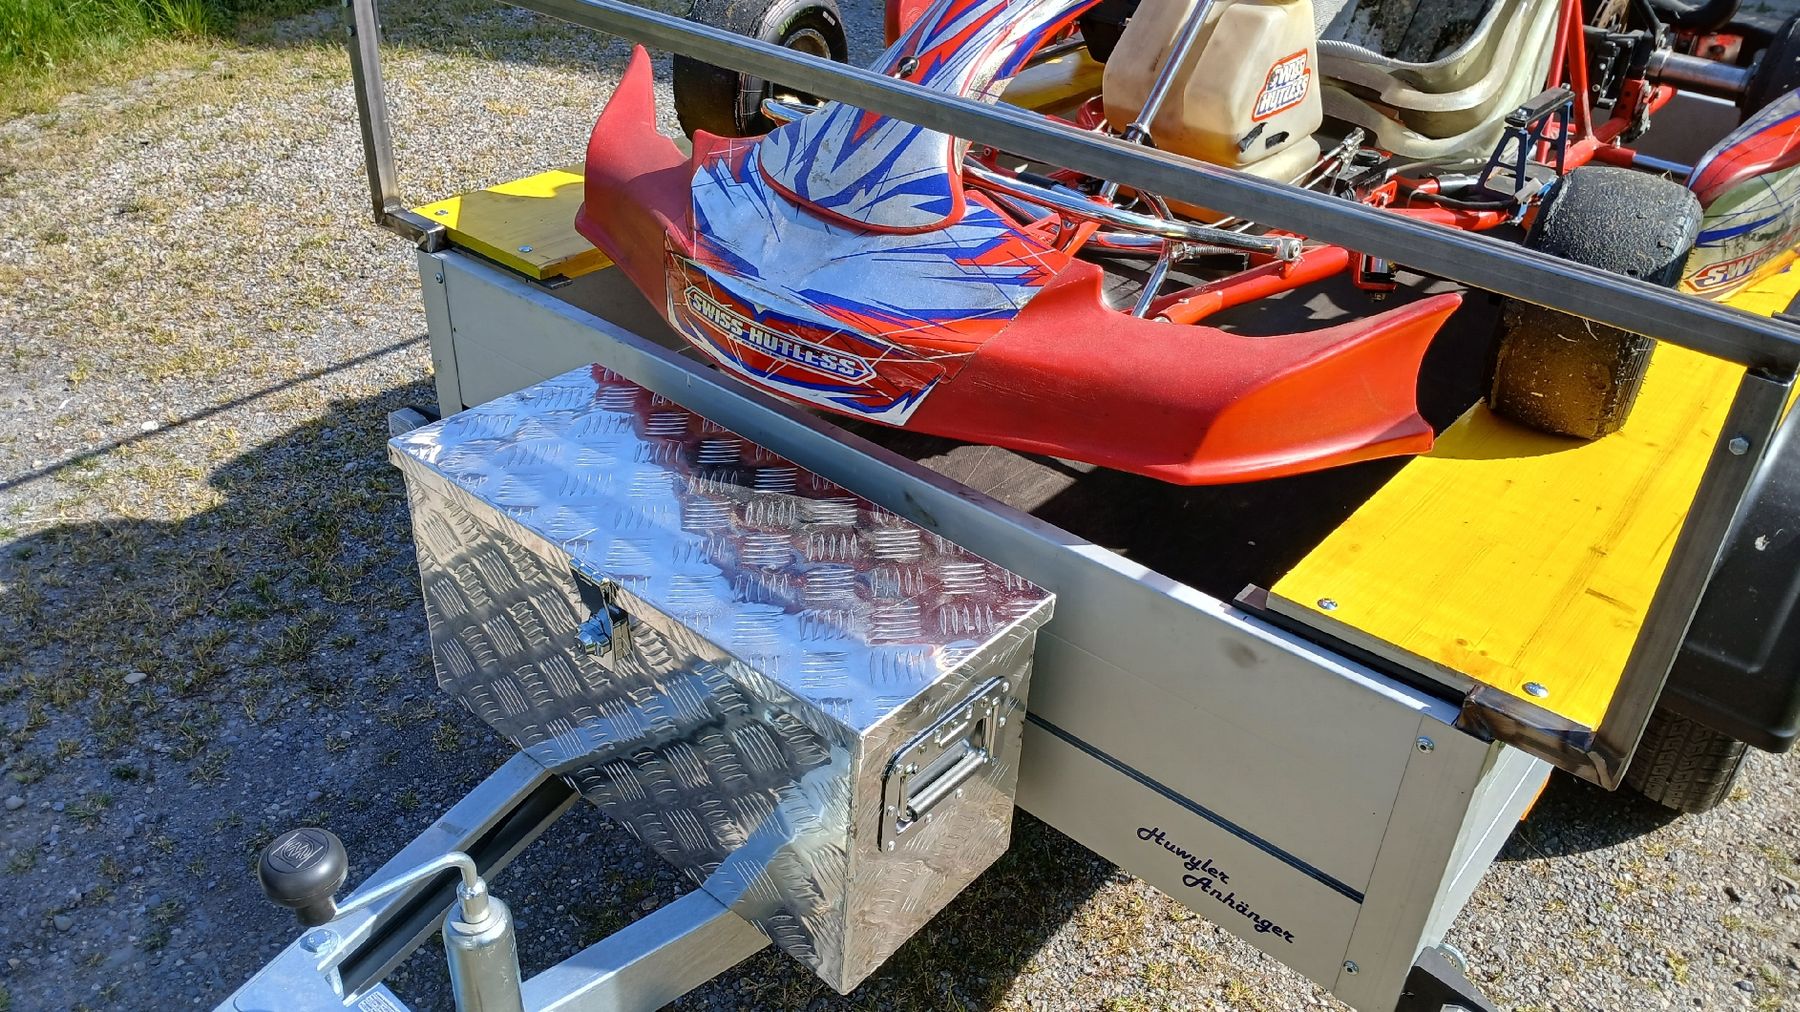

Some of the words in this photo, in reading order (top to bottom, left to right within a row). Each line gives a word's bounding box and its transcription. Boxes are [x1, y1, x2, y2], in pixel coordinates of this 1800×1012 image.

[1256, 76, 1309, 115] HUTLESS
[691, 293, 744, 336] SWISS
[1136, 827, 1230, 885] Huwyler
[1182, 874, 1295, 944] Anhänger
